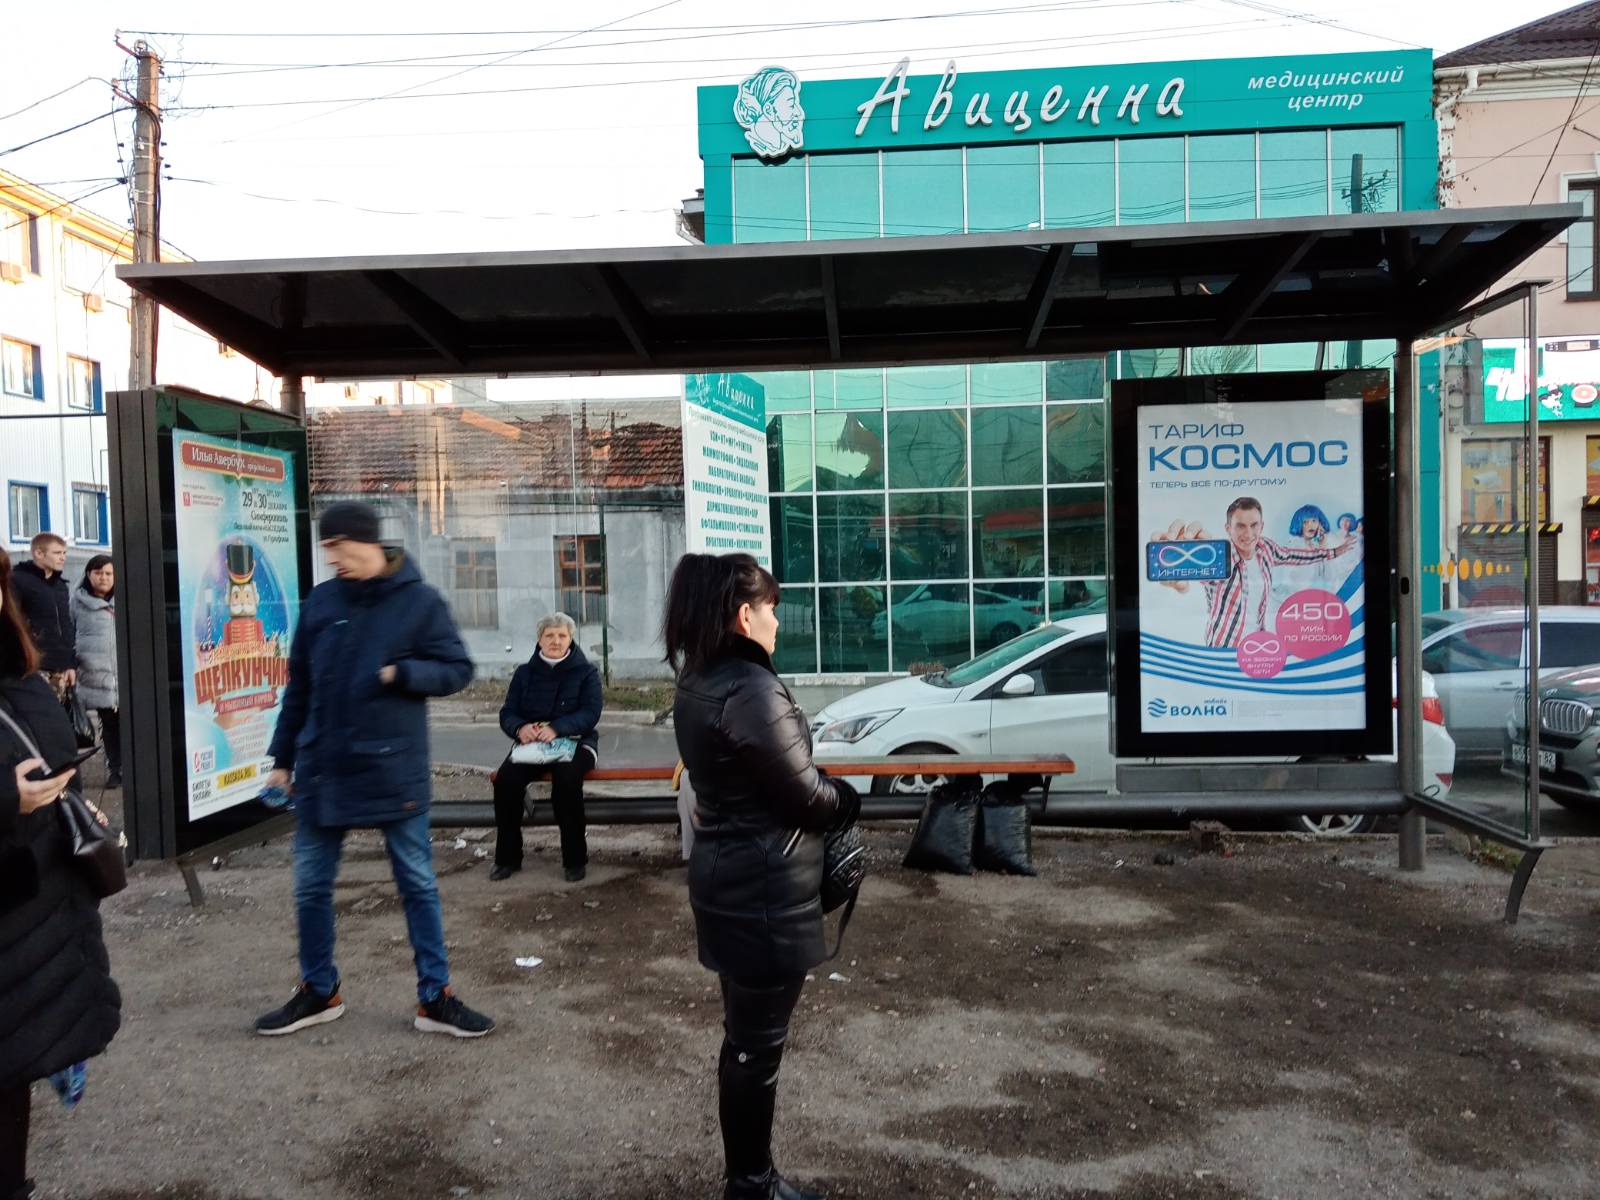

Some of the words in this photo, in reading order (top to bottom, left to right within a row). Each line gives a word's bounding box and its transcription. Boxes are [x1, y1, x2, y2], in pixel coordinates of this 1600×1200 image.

[1247, 66, 1404, 90] медицинский
[855, 56, 1186, 137] Авиценна
[1287, 93, 1363, 112] центр
[1149, 424, 1244, 439] ТАРИФ
[1150, 440, 1348, 471] КОСМОС
[242, 491, 253, 508] 29
[258, 493, 268, 509] 30
[1158, 567, 1217, 577] ИНТЕРНЕТ
[1281, 602, 1343, 622] 450
[1300, 625, 1326, 633] МИН.
